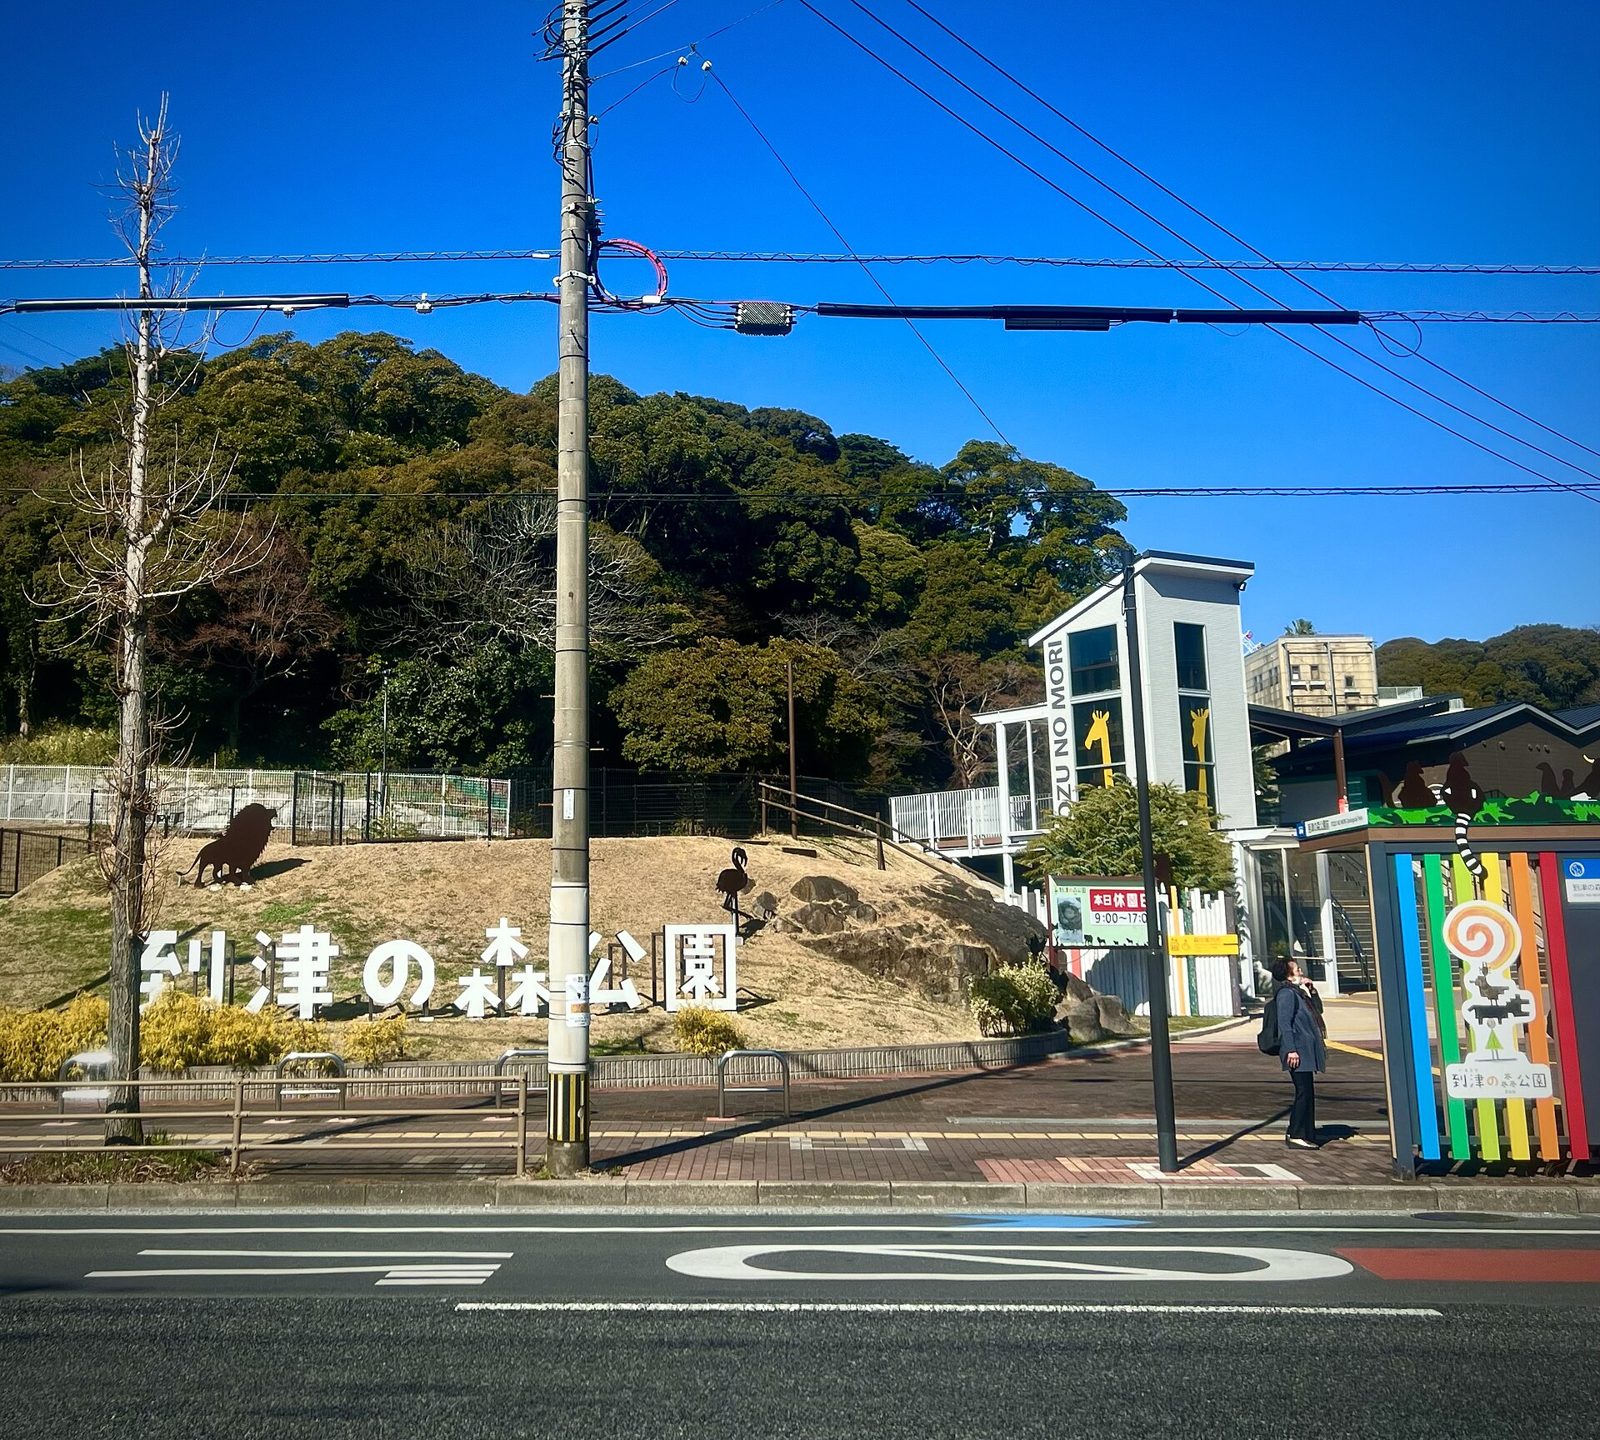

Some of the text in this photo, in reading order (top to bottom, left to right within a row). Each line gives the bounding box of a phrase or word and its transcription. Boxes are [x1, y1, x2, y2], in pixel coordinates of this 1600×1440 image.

[1048, 640, 1072, 816] OZU NO MORI
[139, 917, 737, 1020] 到津の森公園
[1452, 1072, 1547, 1088] 到津の森公園
